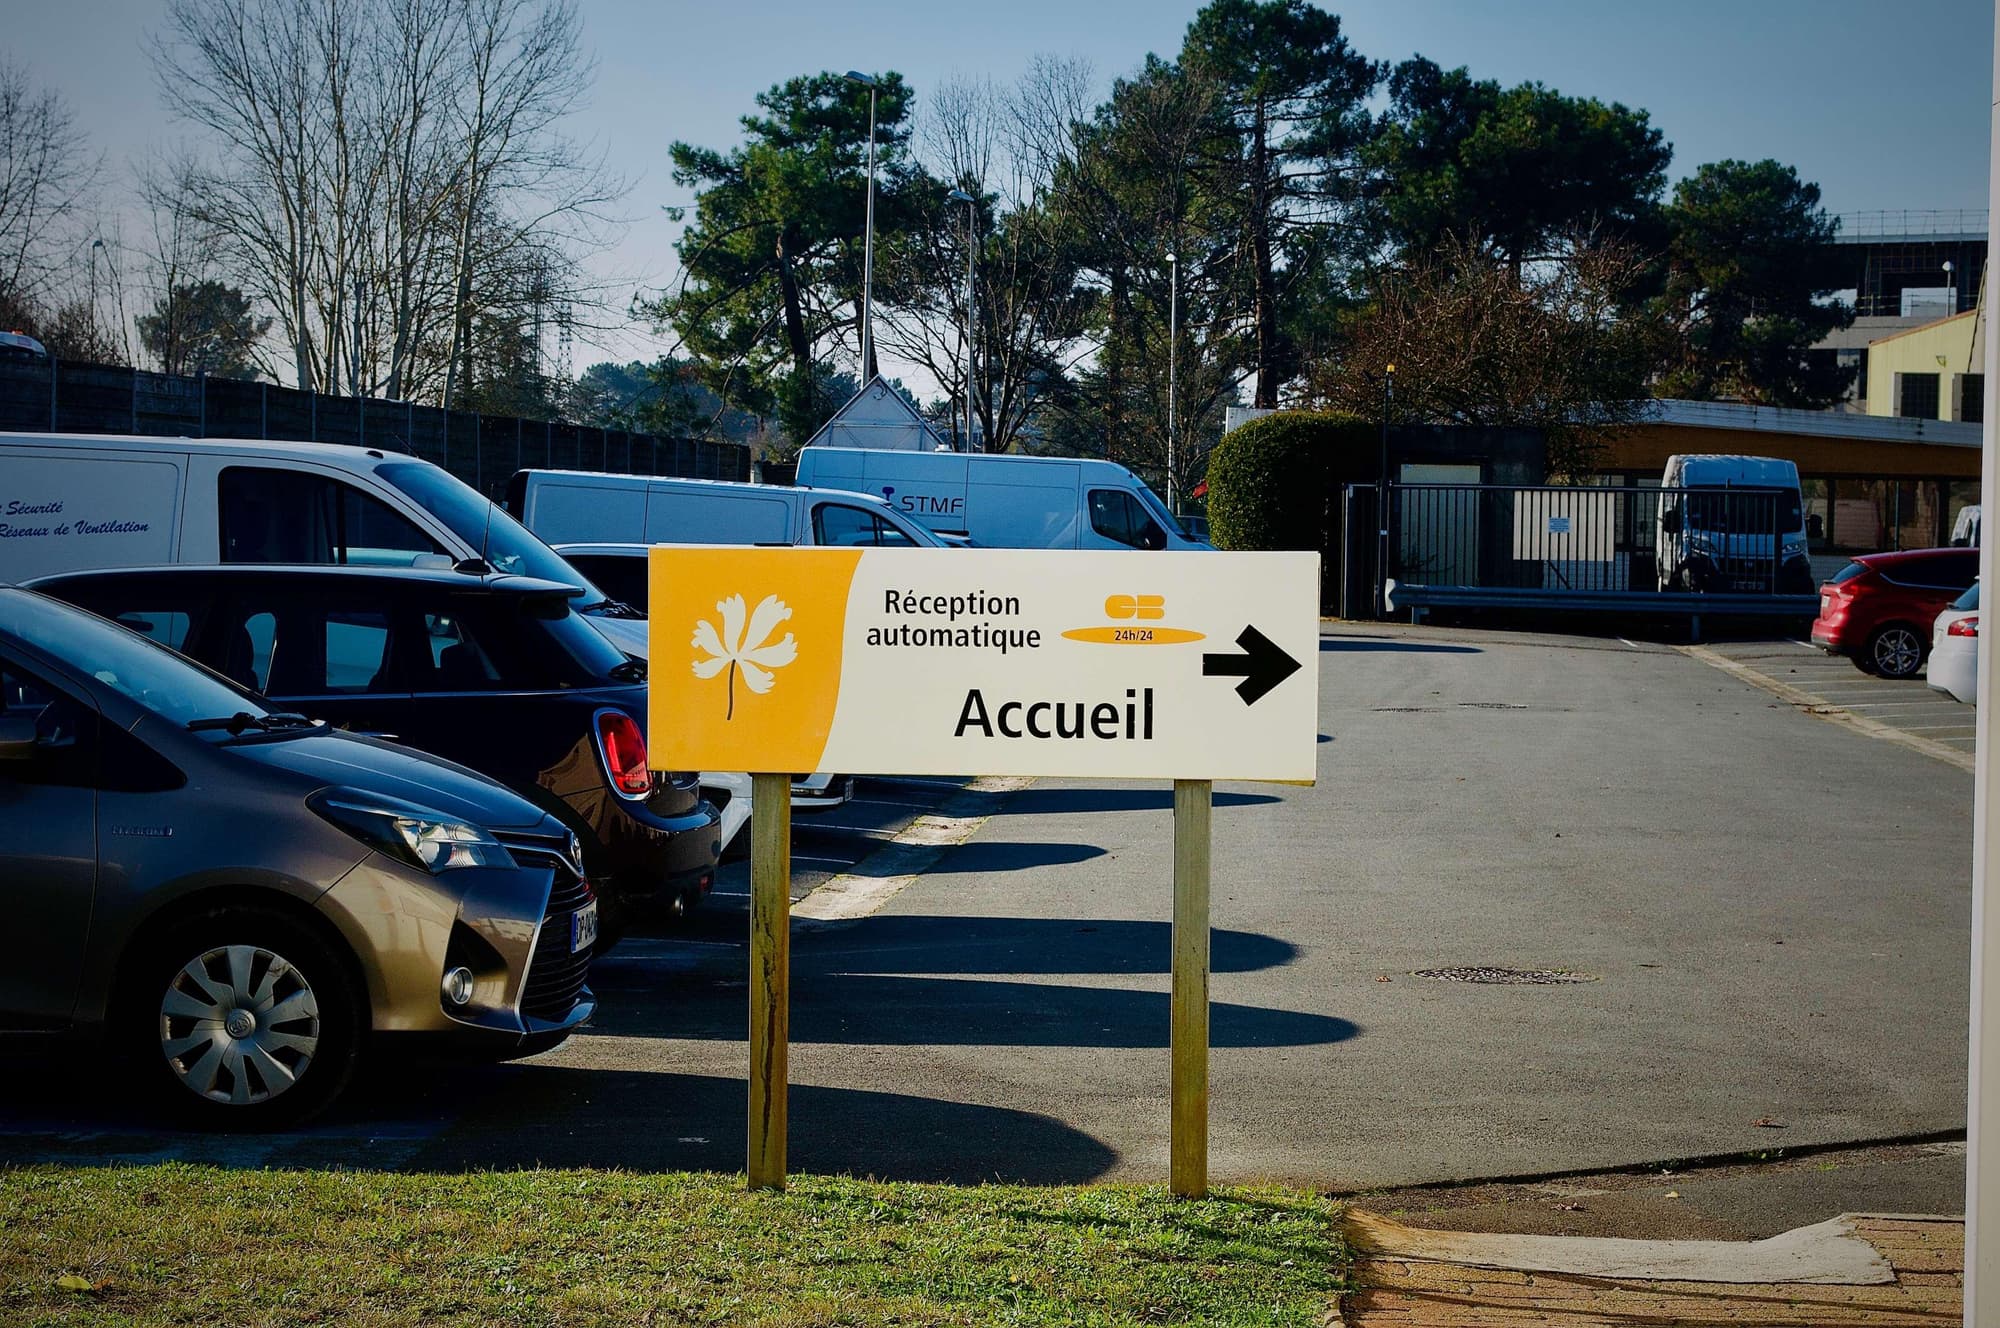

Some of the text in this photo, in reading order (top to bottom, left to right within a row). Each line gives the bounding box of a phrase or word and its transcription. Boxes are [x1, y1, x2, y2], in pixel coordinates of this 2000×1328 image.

[6, 500, 64, 515] Sécurité
[901, 496, 964, 513] STMF
[54, 522, 70, 536] de
[74, 519, 149, 535] Ventilation
[885, 589, 1020, 622] Réception
[866, 622, 1041, 655] automatique
[1114, 630, 1153, 641] 24h/24
[953, 687, 1154, 740] Accueil
